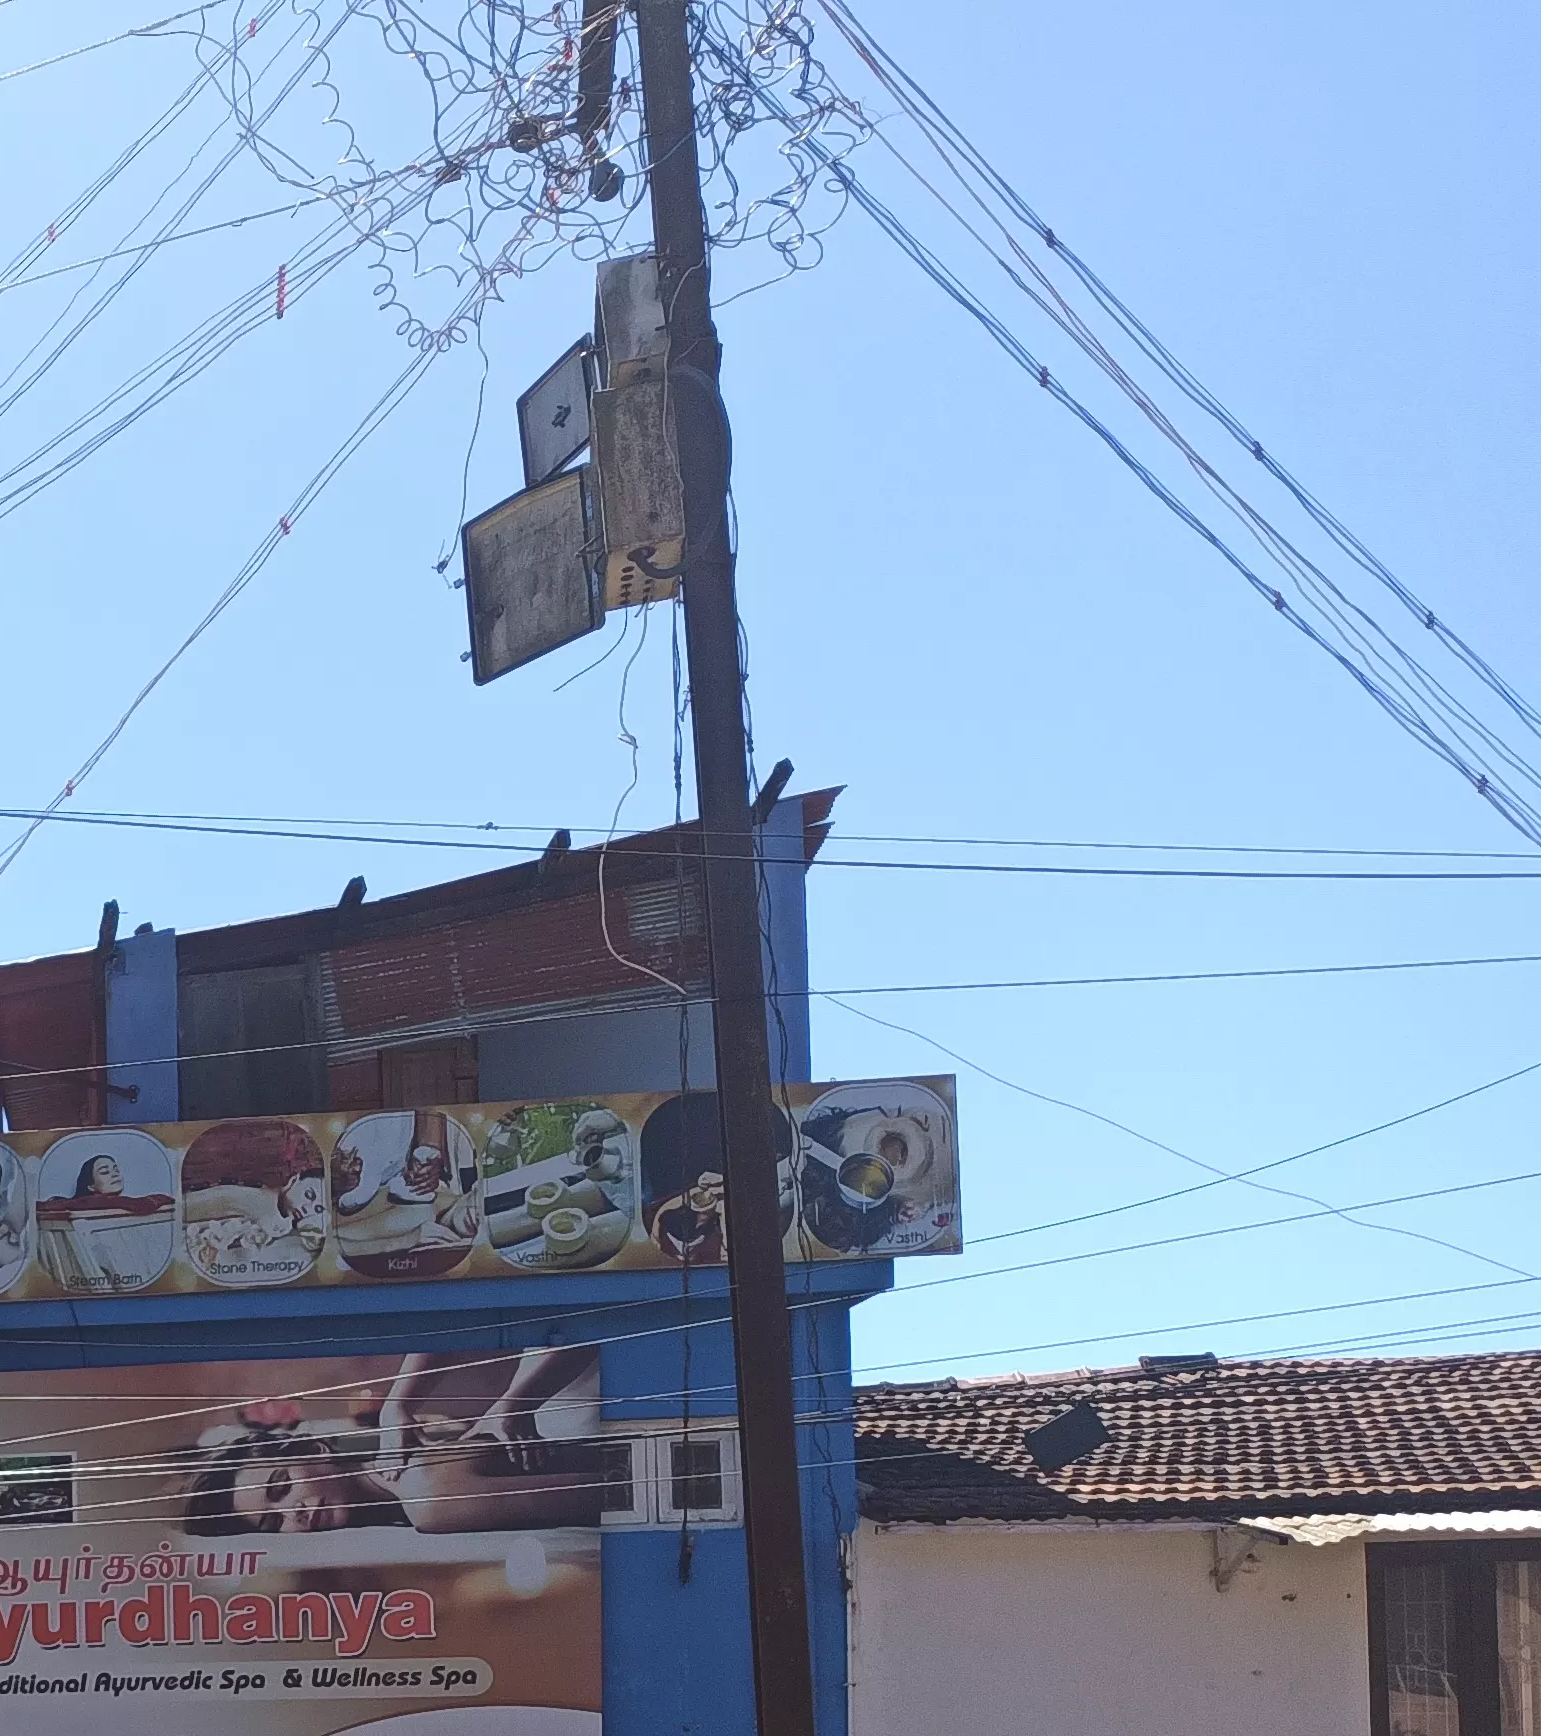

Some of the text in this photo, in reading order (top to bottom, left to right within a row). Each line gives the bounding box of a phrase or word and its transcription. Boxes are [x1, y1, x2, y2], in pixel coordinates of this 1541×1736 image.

[209, 1259, 305, 1276] Stone Therapy
[69, 1273, 143, 1288] Steam Bath
[94, 1670, 214, 1698] Ayurvedic
[219, 1669, 266, 1694] Spa
[282, 1668, 303, 1688] &
[311, 1667, 422, 1688] Wellness
[429, 1665, 478, 1686] Spa
